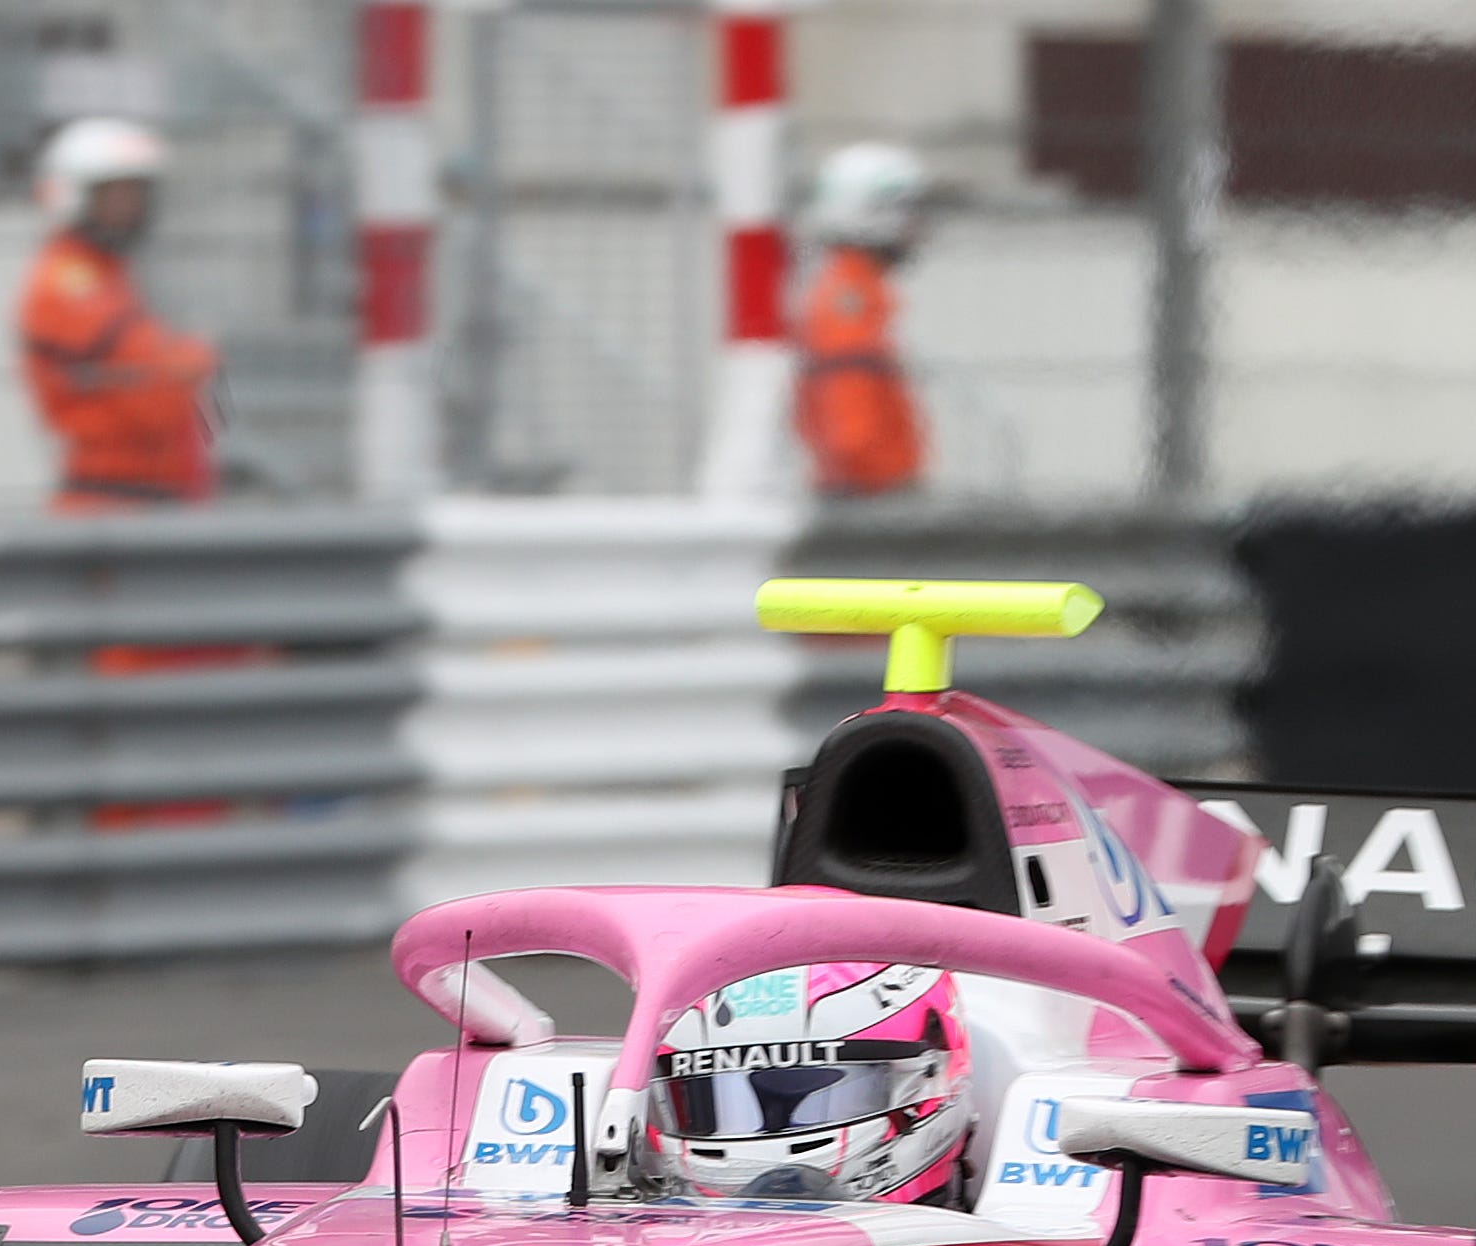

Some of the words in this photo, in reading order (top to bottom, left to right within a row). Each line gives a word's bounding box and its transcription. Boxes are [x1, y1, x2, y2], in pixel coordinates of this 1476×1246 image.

[734, 999, 800, 1018] DROP
[671, 1041, 845, 1077] RENAULT
[81, 1076, 115, 1112] WT
[474, 1142, 576, 1165] BWT
[1246, 1125, 1313, 1163] BW
[998, 1161, 1102, 1187] BWT
